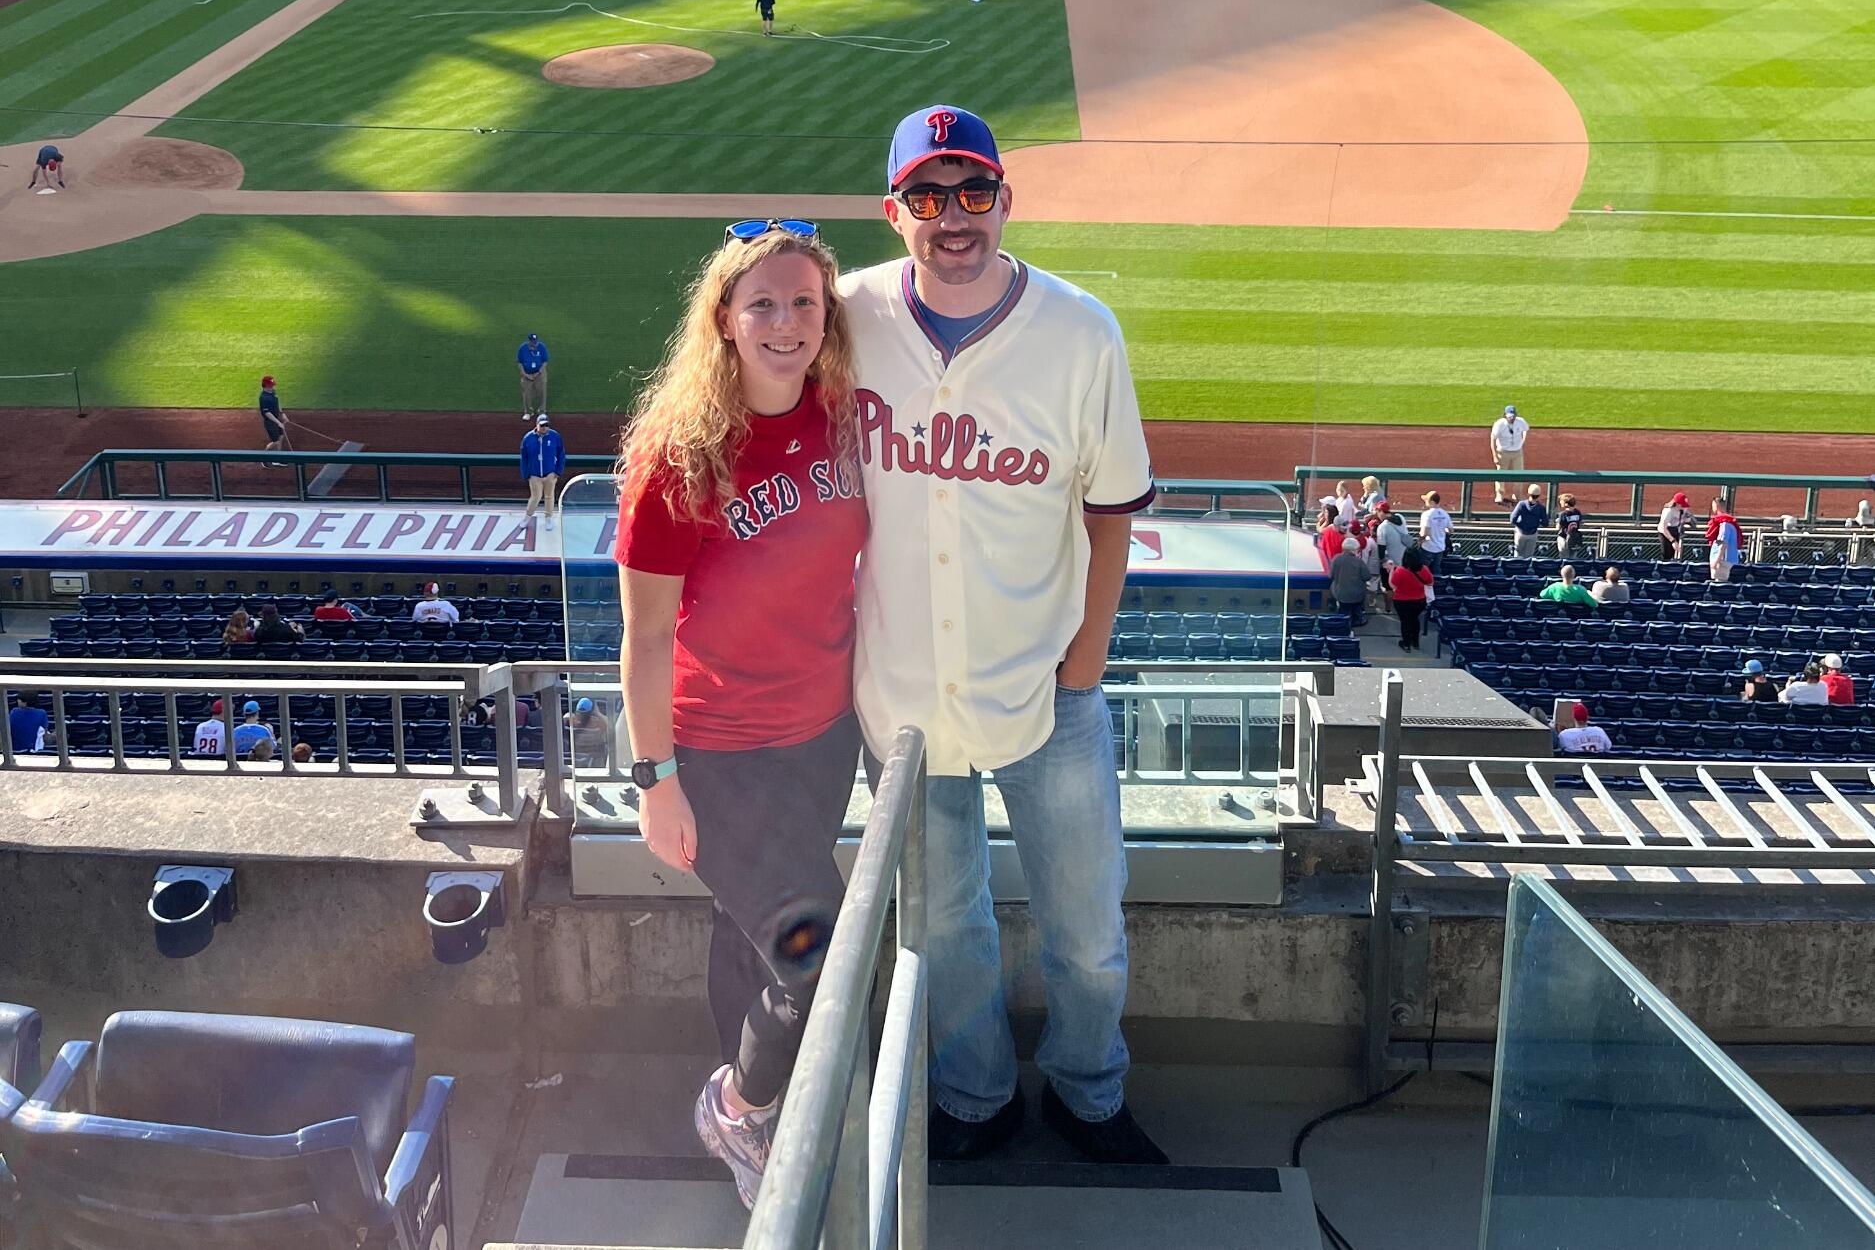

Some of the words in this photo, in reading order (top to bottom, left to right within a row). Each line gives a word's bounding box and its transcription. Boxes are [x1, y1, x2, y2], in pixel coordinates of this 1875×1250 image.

[925, 110, 958, 143] P
[853, 388, 1050, 485] Phillies
[723, 473, 800, 540] RED
[809, 458, 865, 502] SO
[41, 509, 537, 553] PHILADELPHIA
